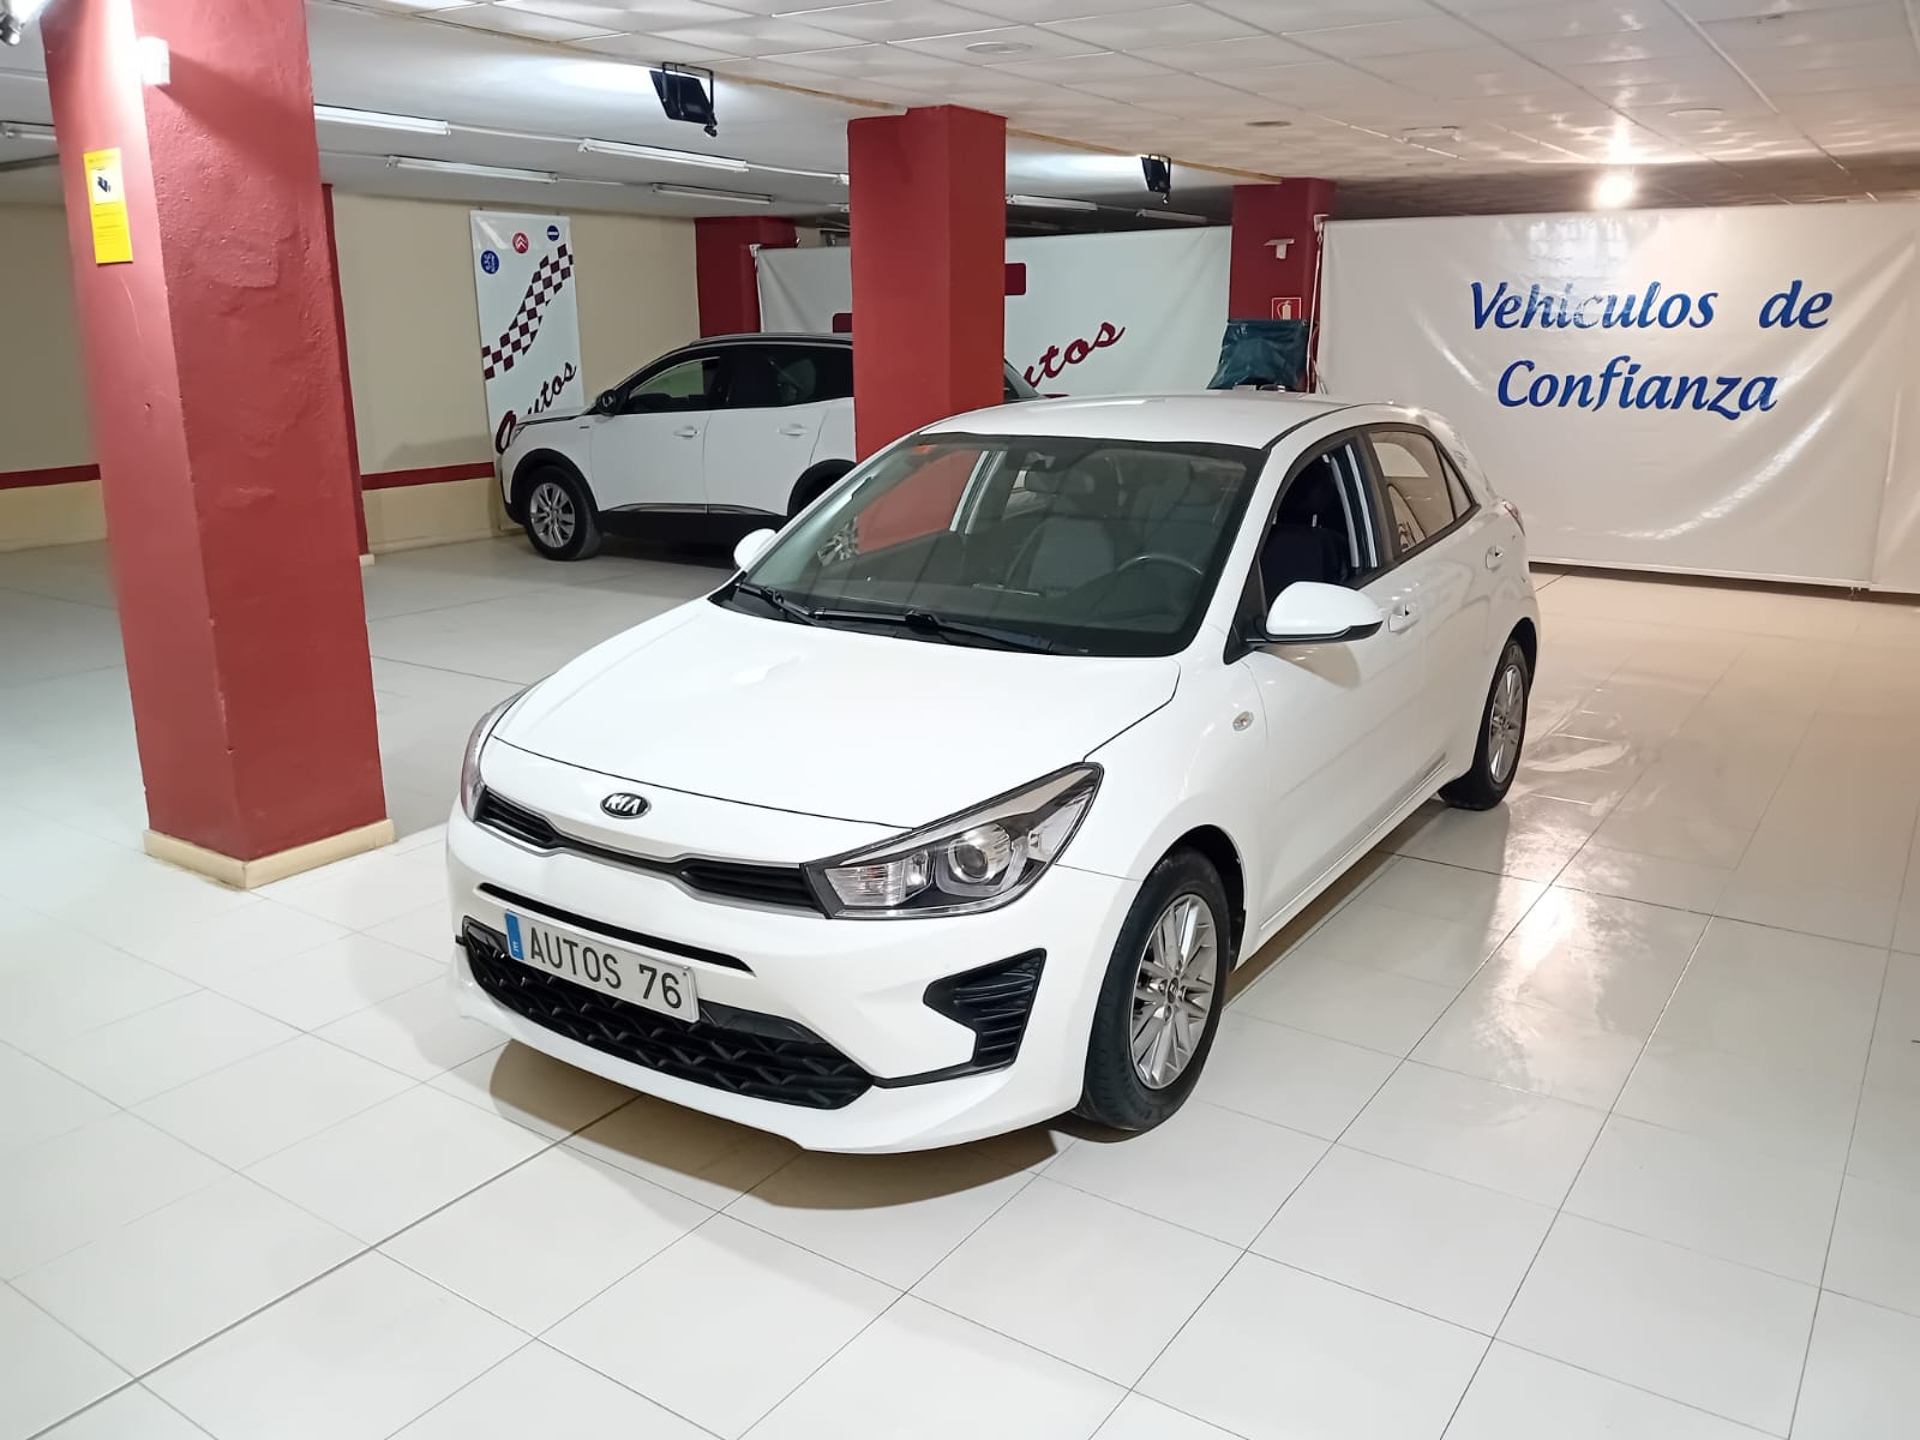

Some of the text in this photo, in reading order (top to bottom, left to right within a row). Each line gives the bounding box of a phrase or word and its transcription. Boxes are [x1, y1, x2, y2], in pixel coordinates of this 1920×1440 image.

[1470, 279, 1833, 330] Vehiculos de
[1498, 354, 1778, 421] Confianza
[604, 794, 641, 814] KIA
[530, 926, 683, 1009] AUTOS 76
